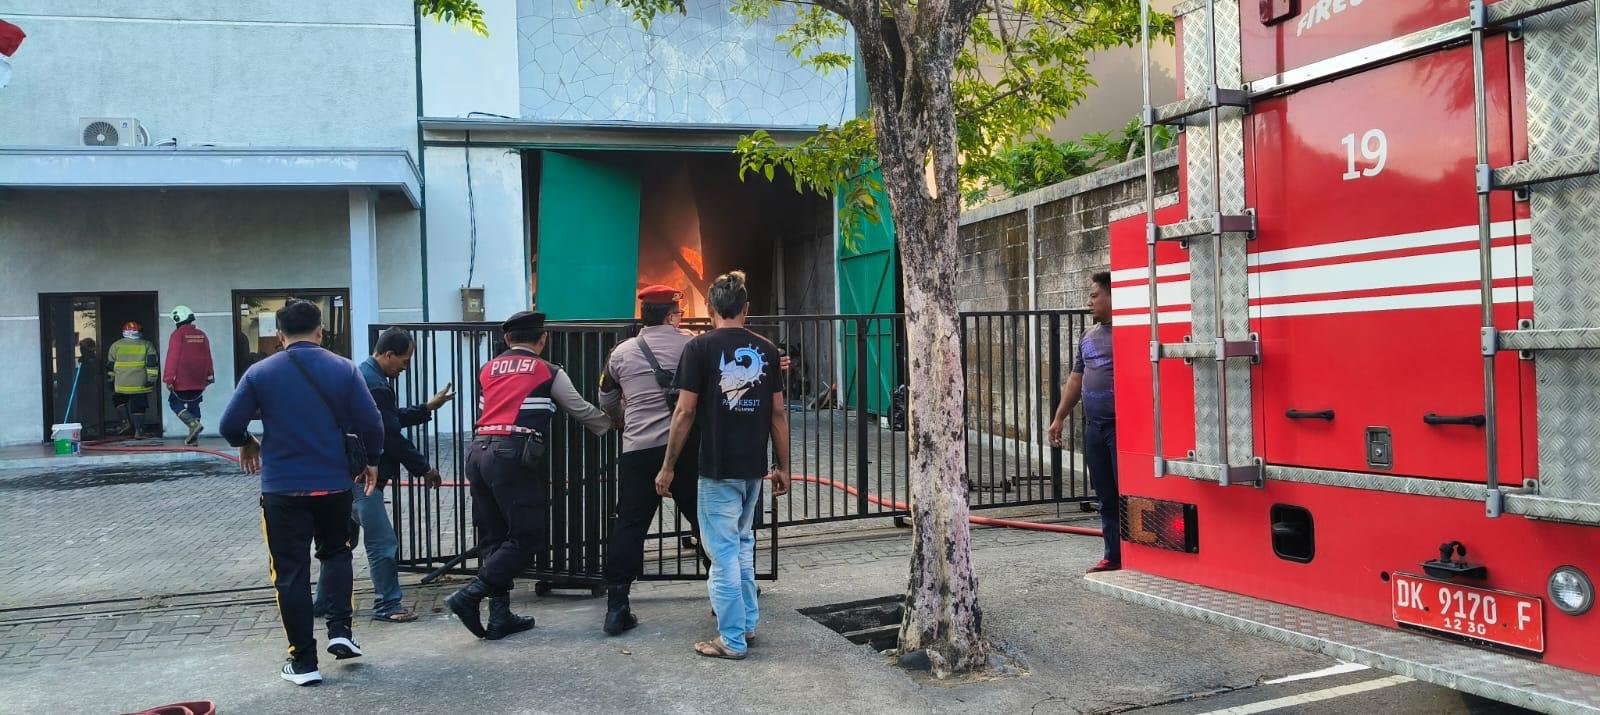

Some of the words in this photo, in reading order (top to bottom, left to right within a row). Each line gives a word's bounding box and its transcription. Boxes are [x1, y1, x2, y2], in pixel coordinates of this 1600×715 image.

[1296, 0, 1364, 37] FIRE
[1341, 128, 1388, 181] 19
[490, 359, 537, 376] POLISI
[722, 399, 760, 407] PAKESIT
[1396, 579, 1424, 611] DK
[1438, 587, 1498, 625] 9170
[1517, 601, 1532, 631] F
[1444, 617, 1462, 630] 12
